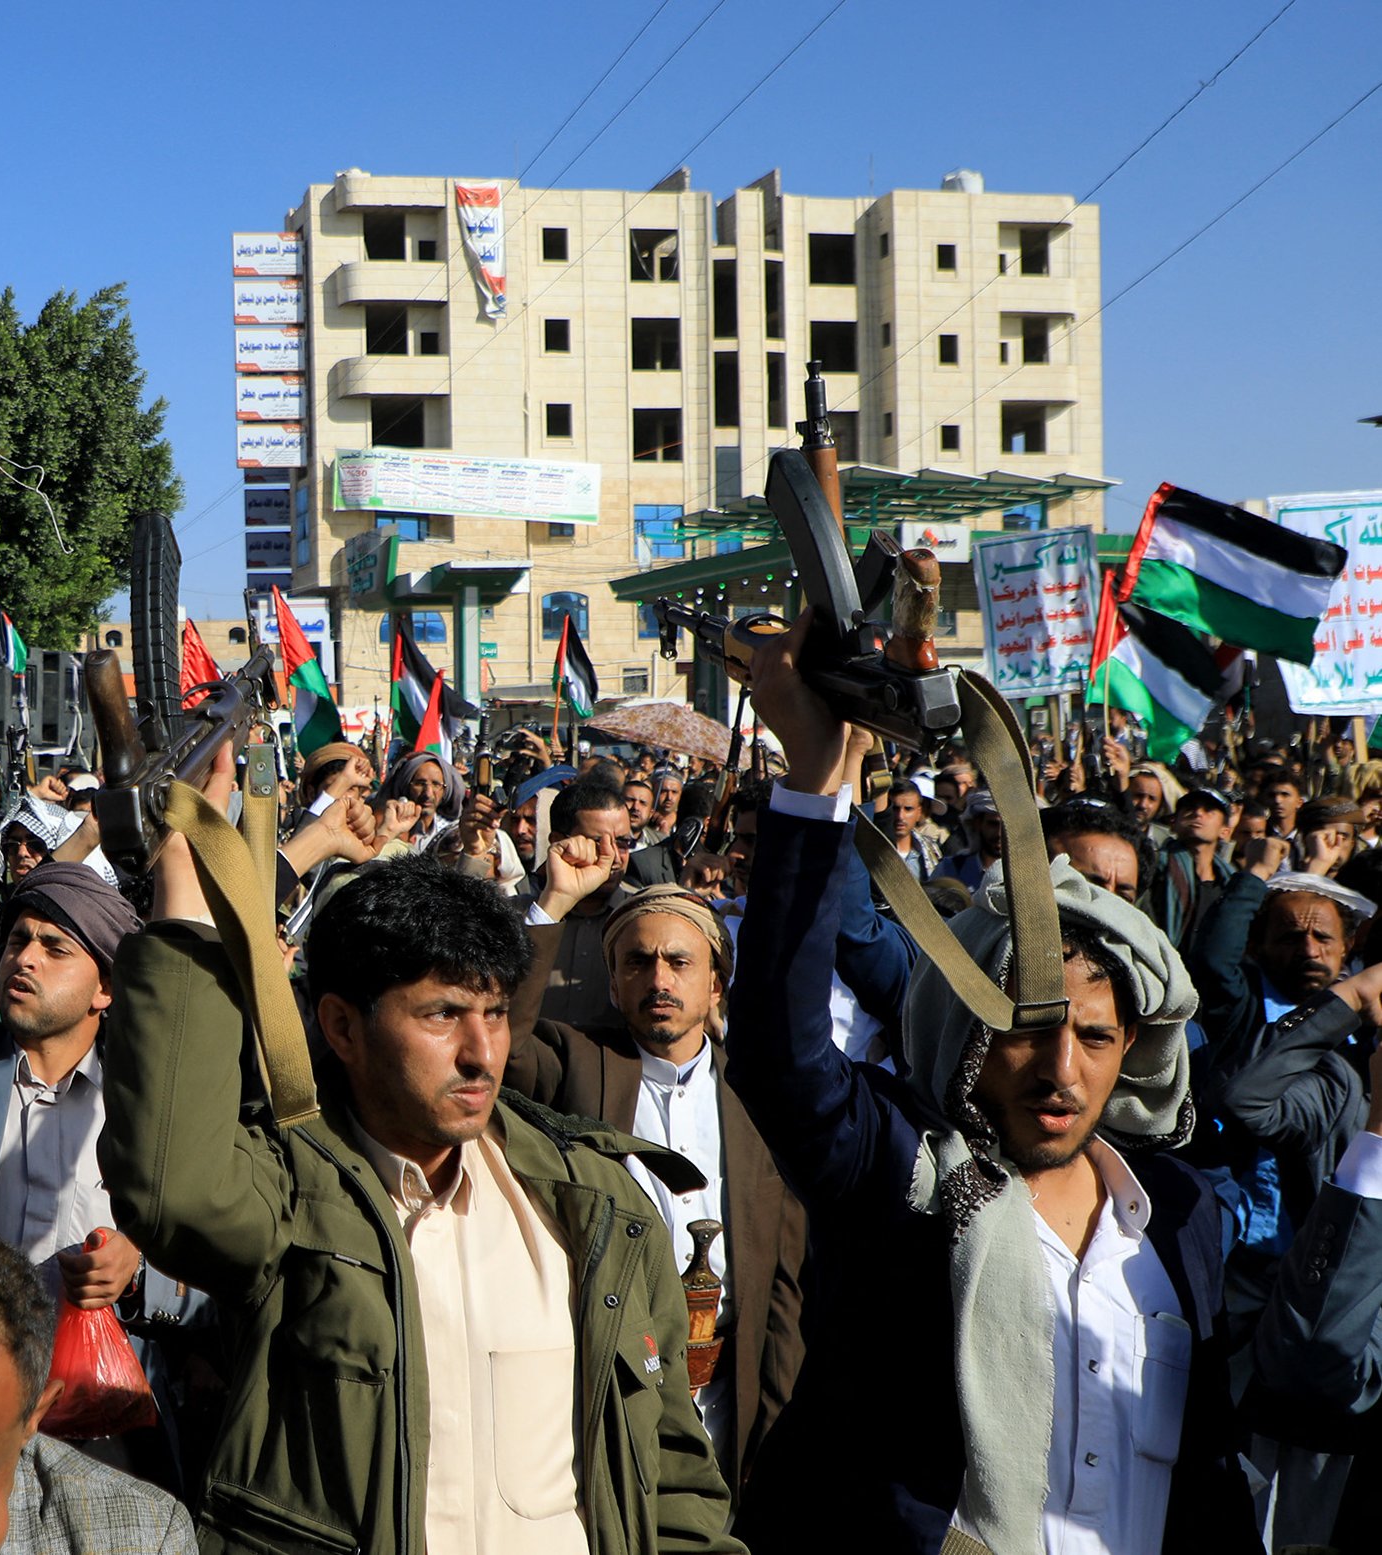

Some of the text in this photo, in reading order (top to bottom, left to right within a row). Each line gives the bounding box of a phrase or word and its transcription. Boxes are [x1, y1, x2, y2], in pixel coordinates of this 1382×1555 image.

[989, 540, 1086, 583] الله أكبر
[991, 576, 1087, 603] الموت لأمريكا
[1047, 602, 1089, 623] الموت
[998, 636, 1032, 657] اليهود
[1036, 633, 1056, 653] على
[1343, 628, 1365, 655] على
